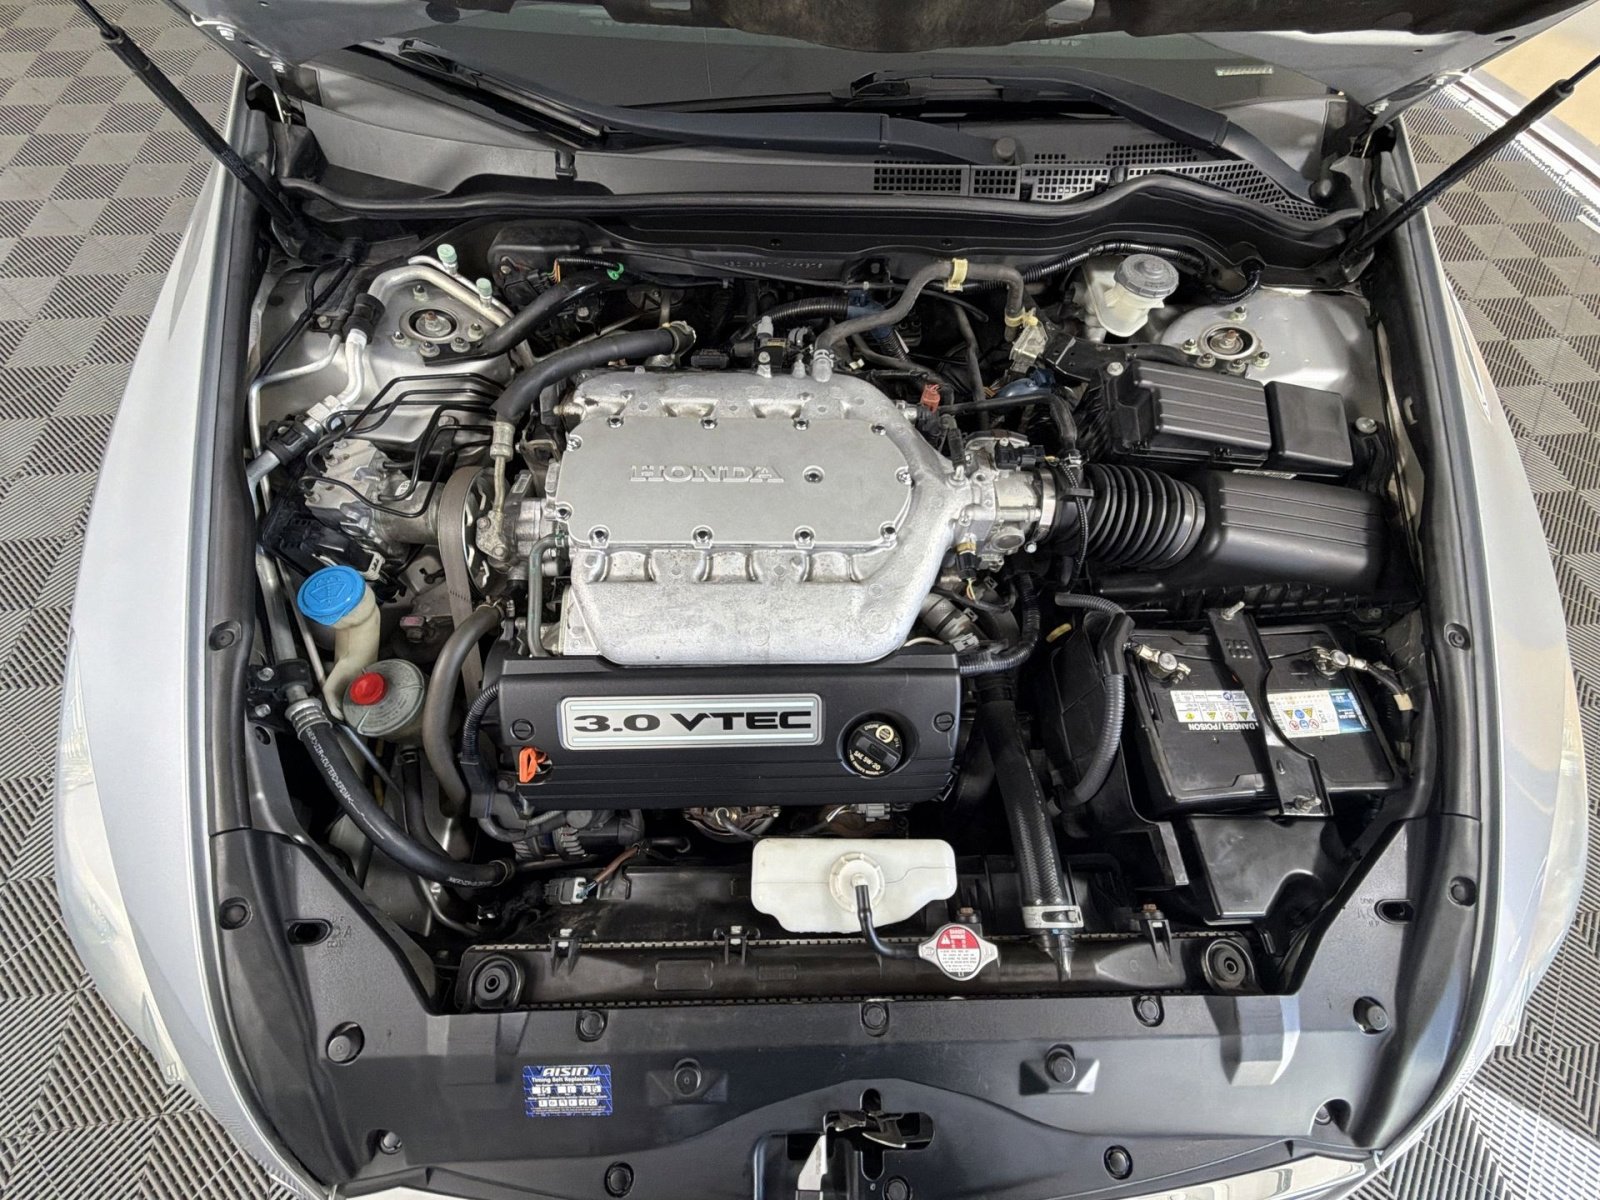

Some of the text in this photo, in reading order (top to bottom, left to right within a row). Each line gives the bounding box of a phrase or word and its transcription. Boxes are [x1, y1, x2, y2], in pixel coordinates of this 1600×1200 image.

[630, 465, 785, 483] HONDA
[573, 711, 812, 733] 3.0 VTEC
[543, 1067, 589, 1077] AISIN
